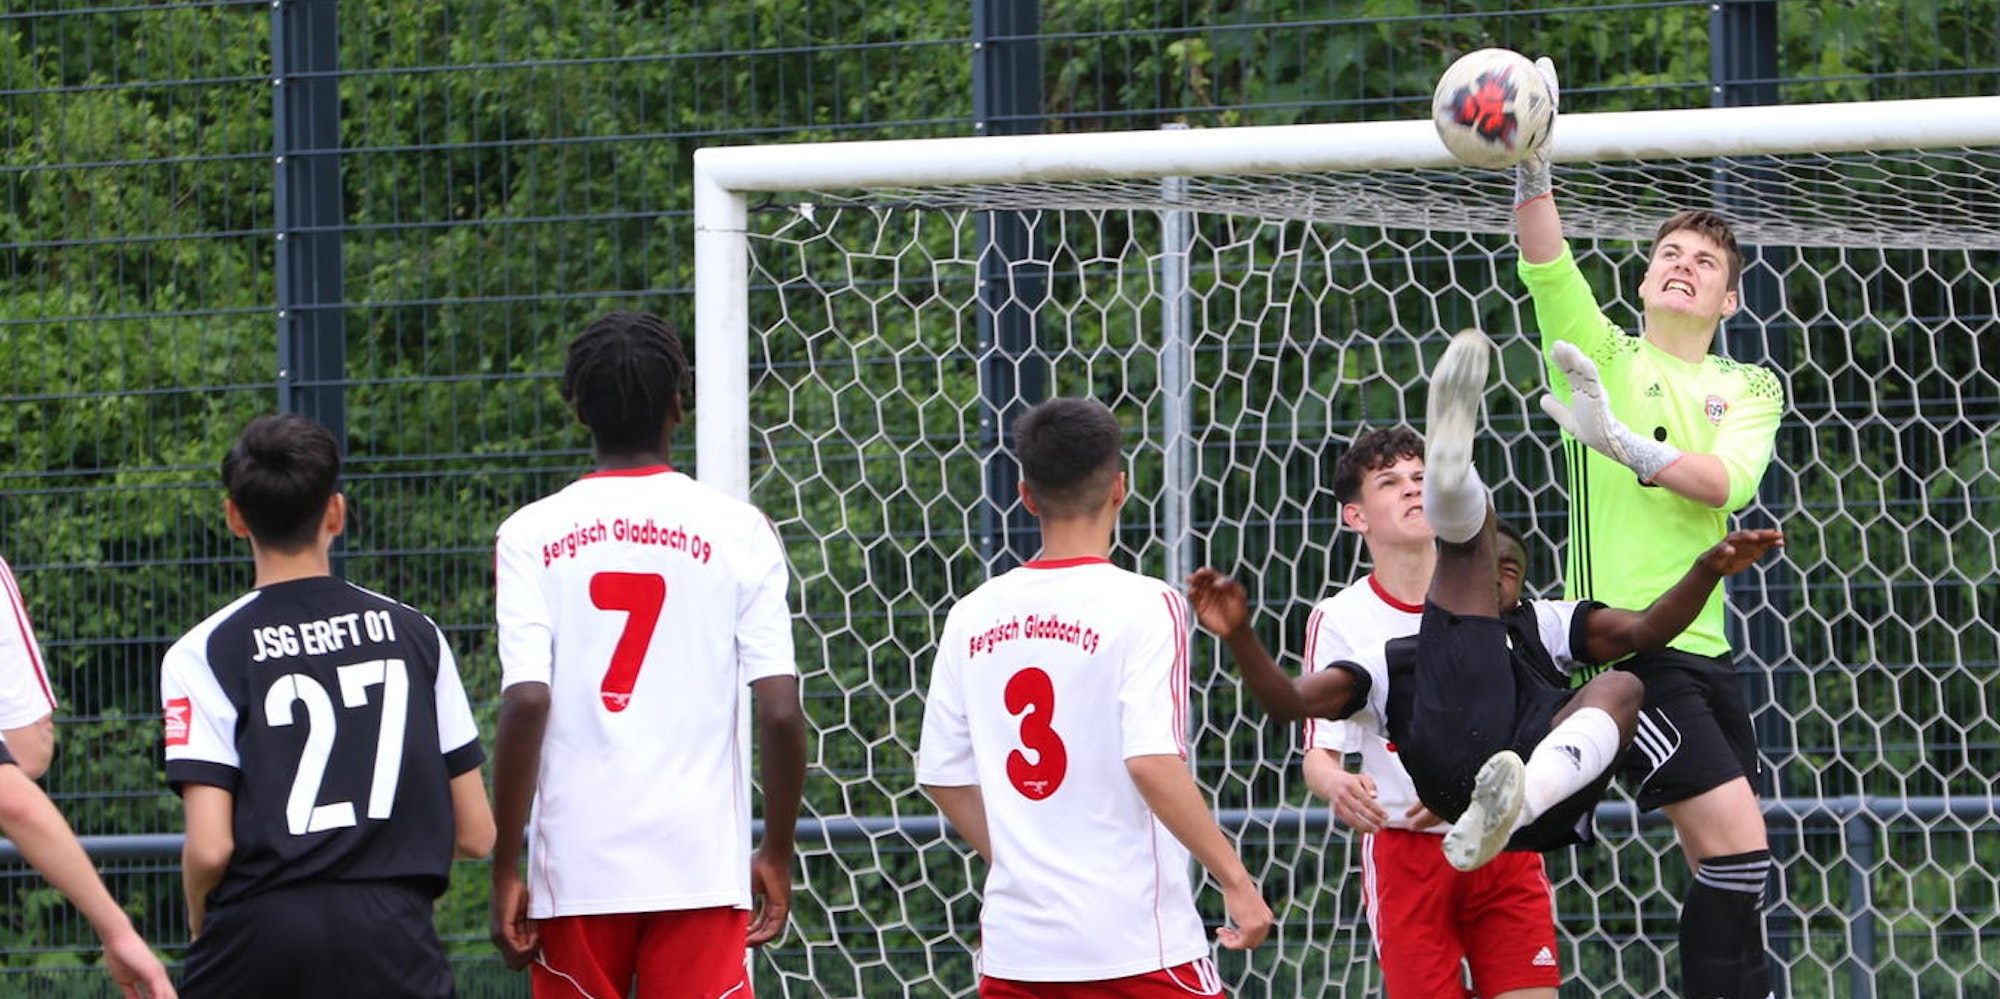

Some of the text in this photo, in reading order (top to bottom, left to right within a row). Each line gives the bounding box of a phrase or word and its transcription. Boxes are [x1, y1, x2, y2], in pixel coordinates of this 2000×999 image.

[542, 518, 712, 568] Bergisch Gladbach 09
[252, 609, 397, 662] JSG ERFT 01
[588, 571, 667, 713] 7
[968, 614, 1100, 660] Bergisch Gladbach 09
[263, 658, 410, 836] 27
[1003, 666, 1068, 801] 3
